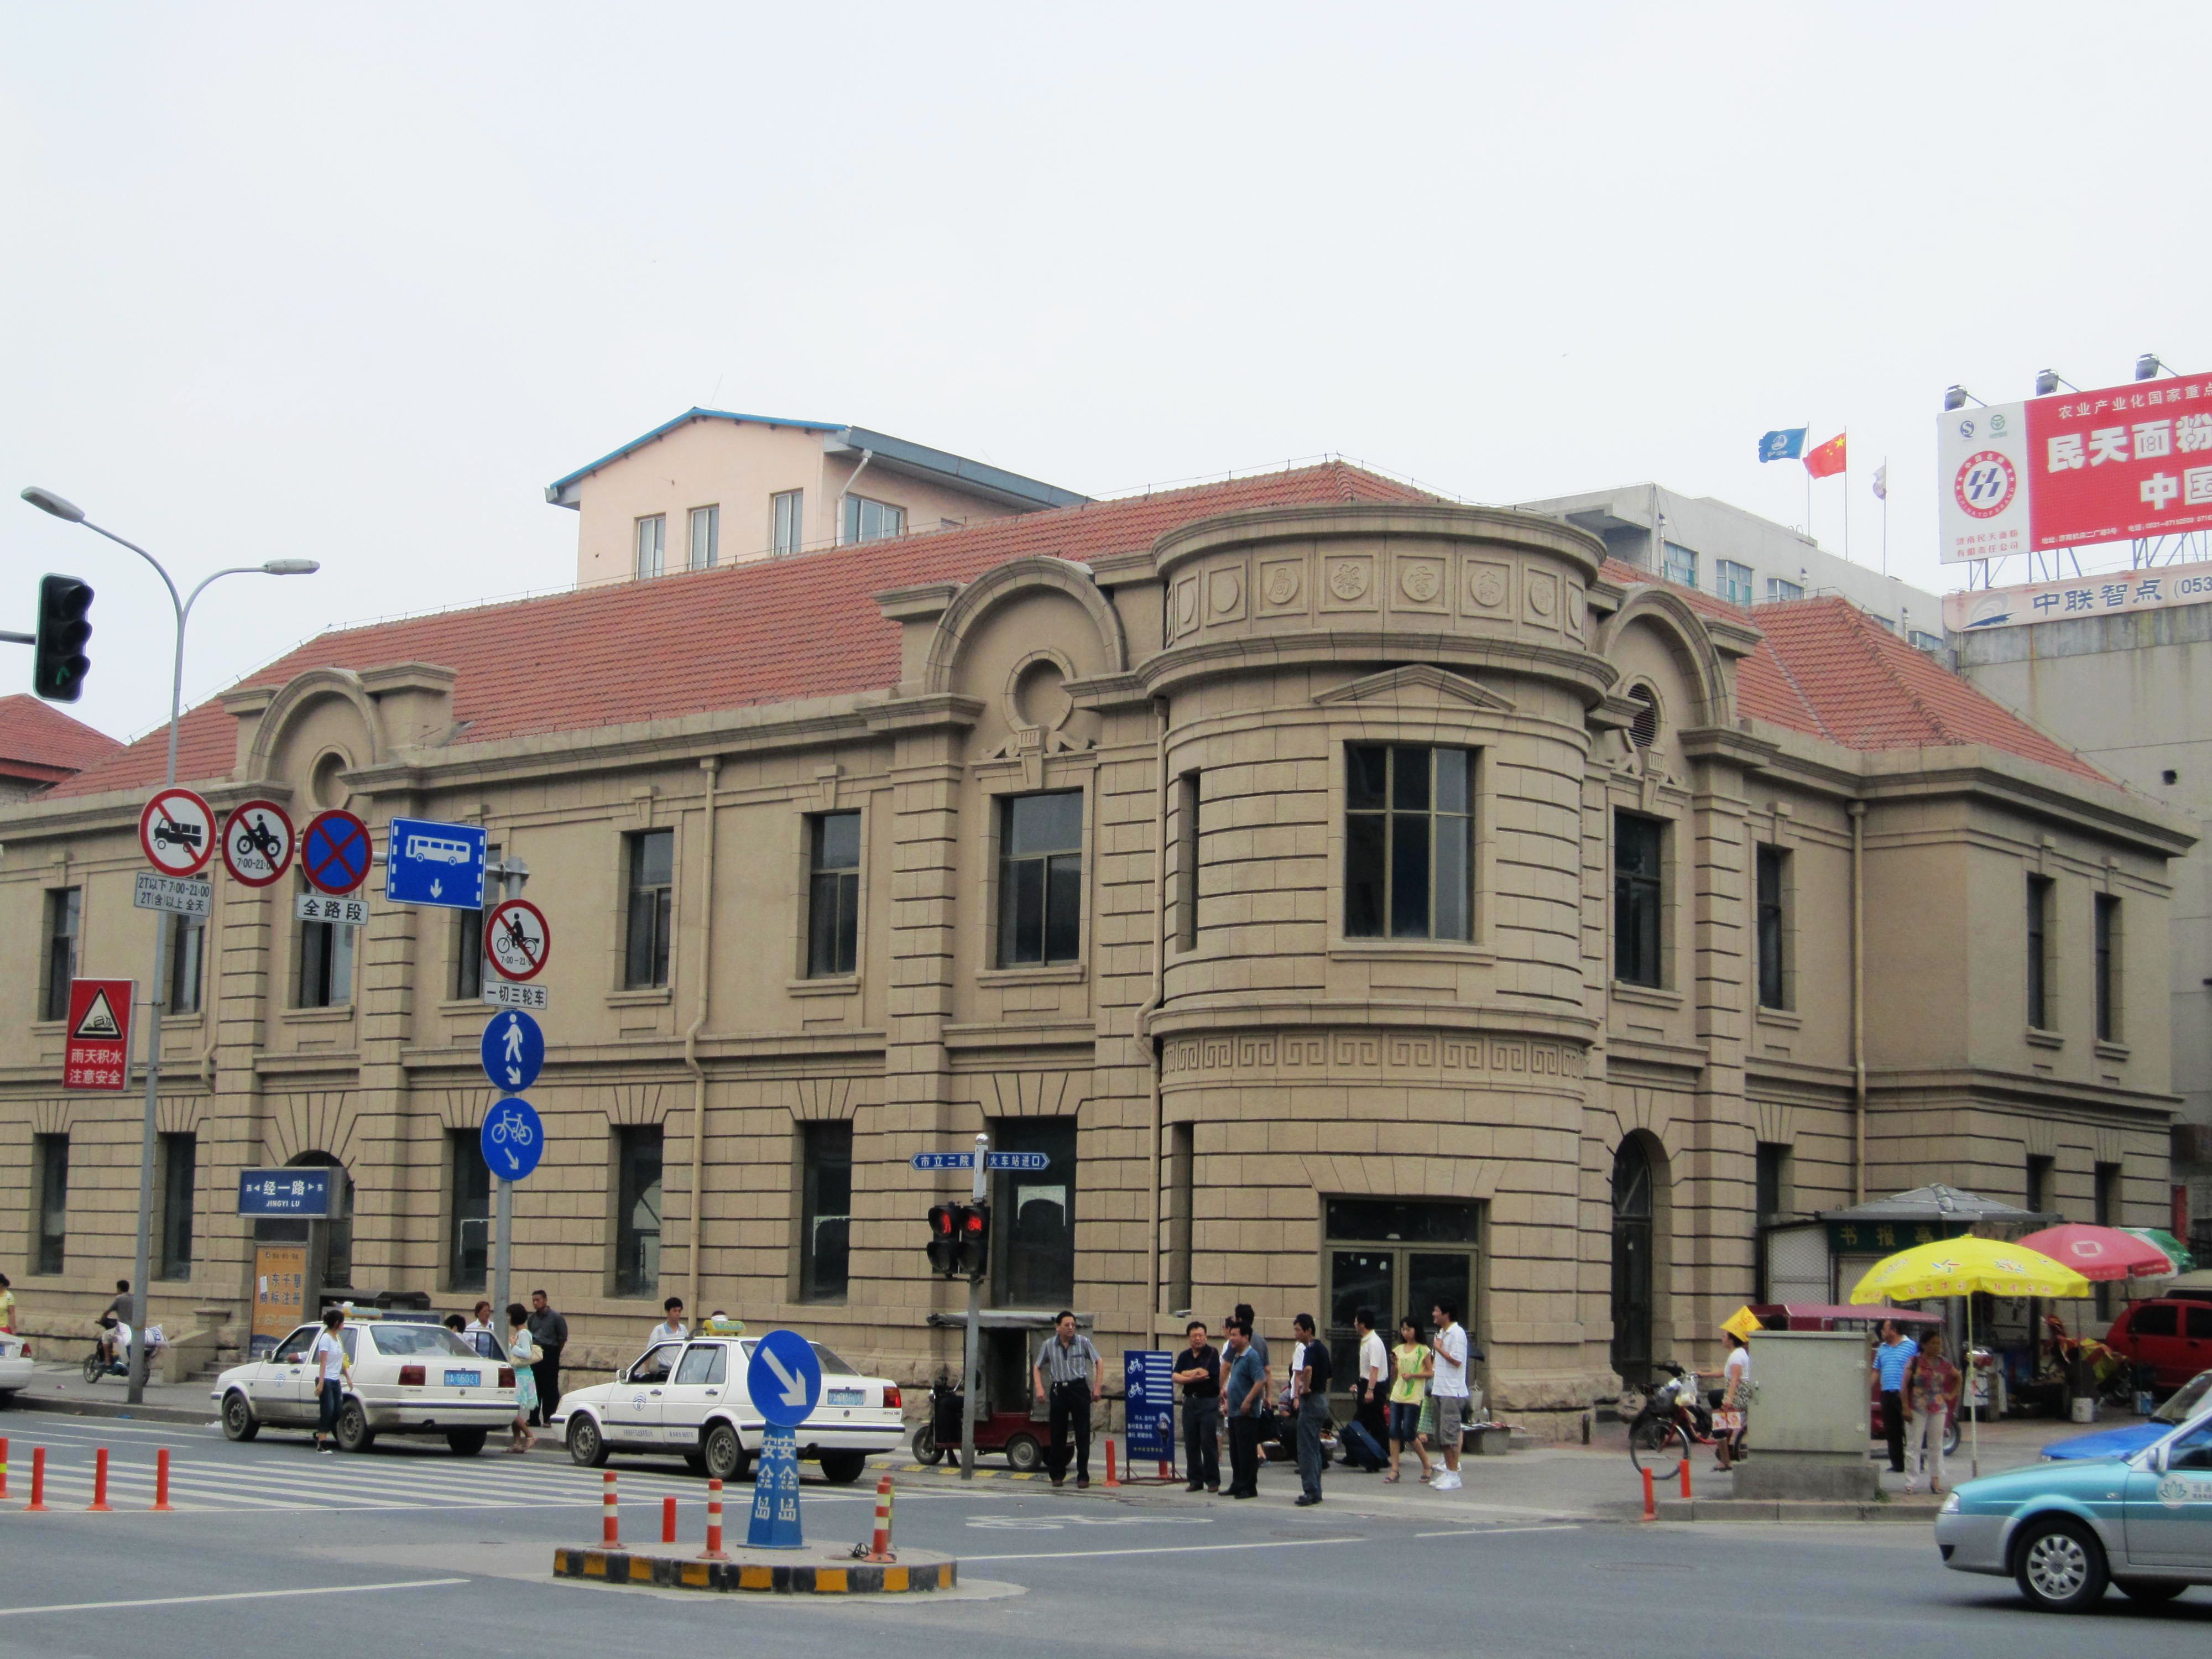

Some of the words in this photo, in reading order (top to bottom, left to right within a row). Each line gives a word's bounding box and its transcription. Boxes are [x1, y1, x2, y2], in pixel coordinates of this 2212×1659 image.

[2048, 413, 2212, 473] 民天面粉
[2140, 465, 2212, 510] 中国
[1957, 529, 2018, 545] 济南民天面粉
[1958, 542, 2018, 557] 有限责任公司
[2033, 578, 2163, 615] 中联智点
[138, 877, 167, 891] 2T以下
[169, 881, 210, 898] 7:00-21:00
[186, 898, 204, 911] 全天
[304, 899, 362, 922] 全路段
[487, 985, 544, 1005] 一切三轮车
[71, 1048, 122, 1064] 雨天积水
[69, 1069, 121, 1084] 注意安全
[921, 1155, 969, 1167] 市立二院
[990, 1155, 1040, 1167] 火车站进口
[263, 1180, 305, 1196] 经一路
